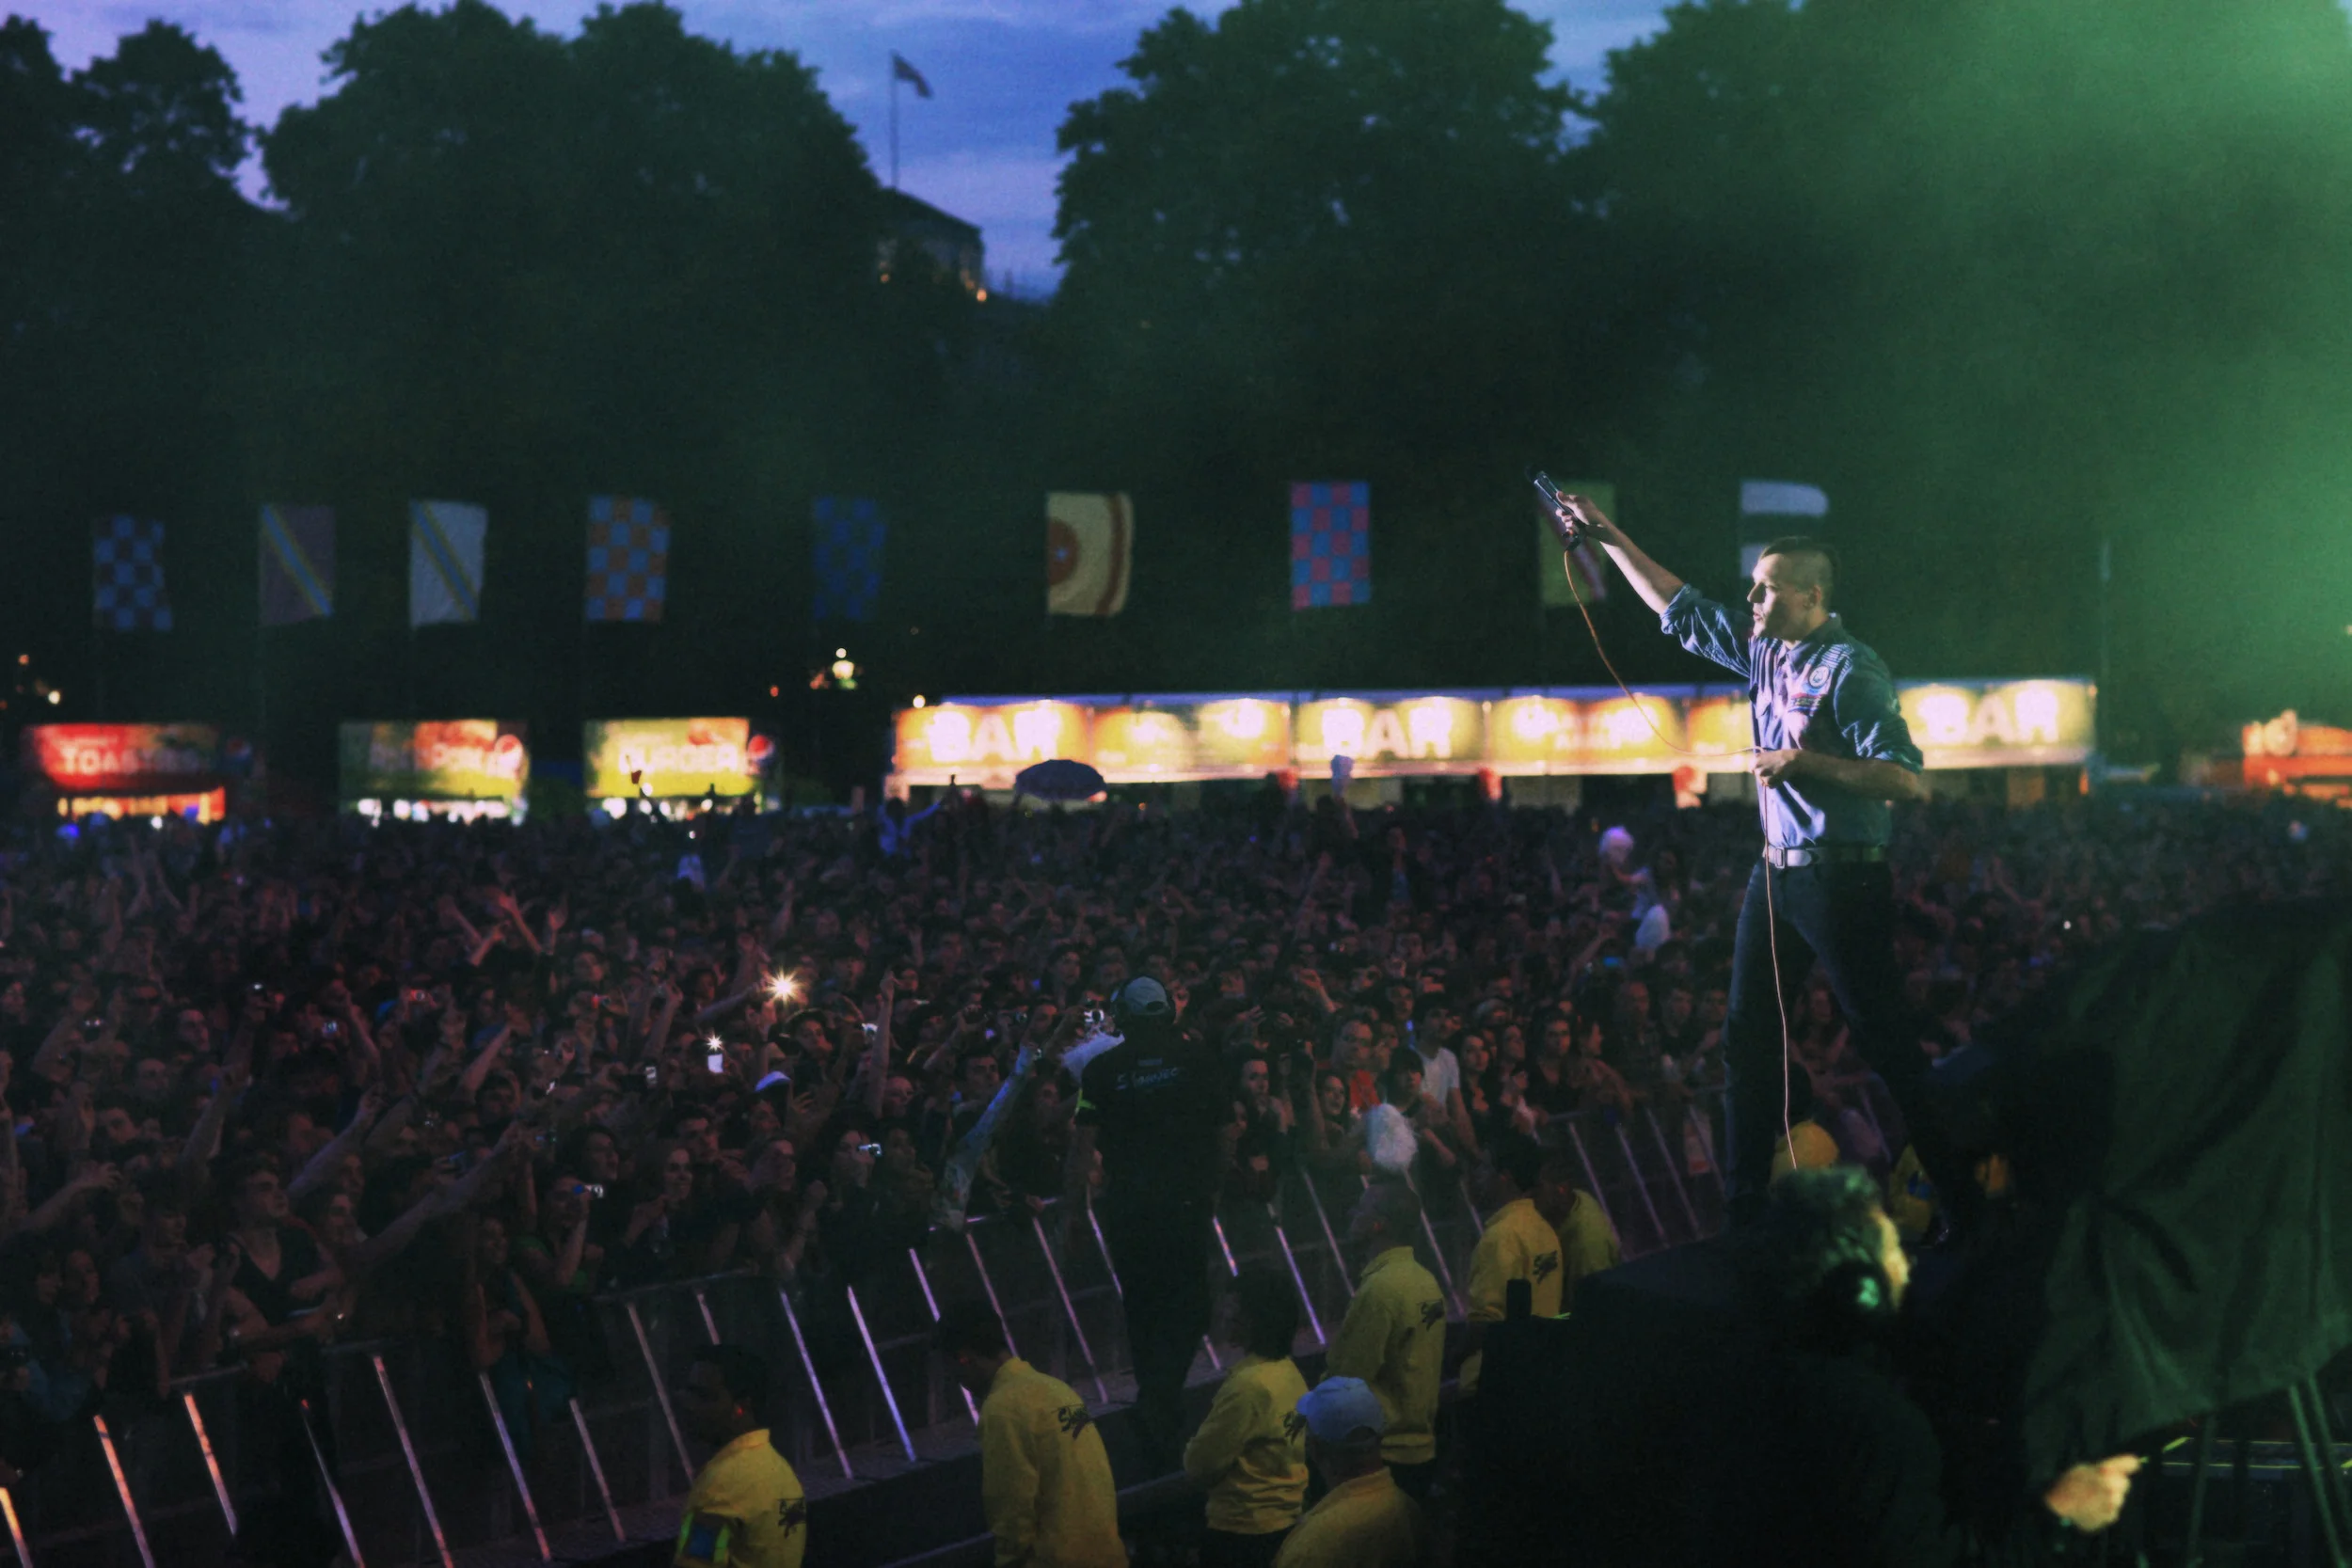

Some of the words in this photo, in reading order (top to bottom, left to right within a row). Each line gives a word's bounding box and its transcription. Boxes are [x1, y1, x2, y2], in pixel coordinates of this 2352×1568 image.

[928, 711, 1061, 761] BAR
[1322, 709, 1451, 759] BAR
[1917, 693, 2058, 743] BAR
